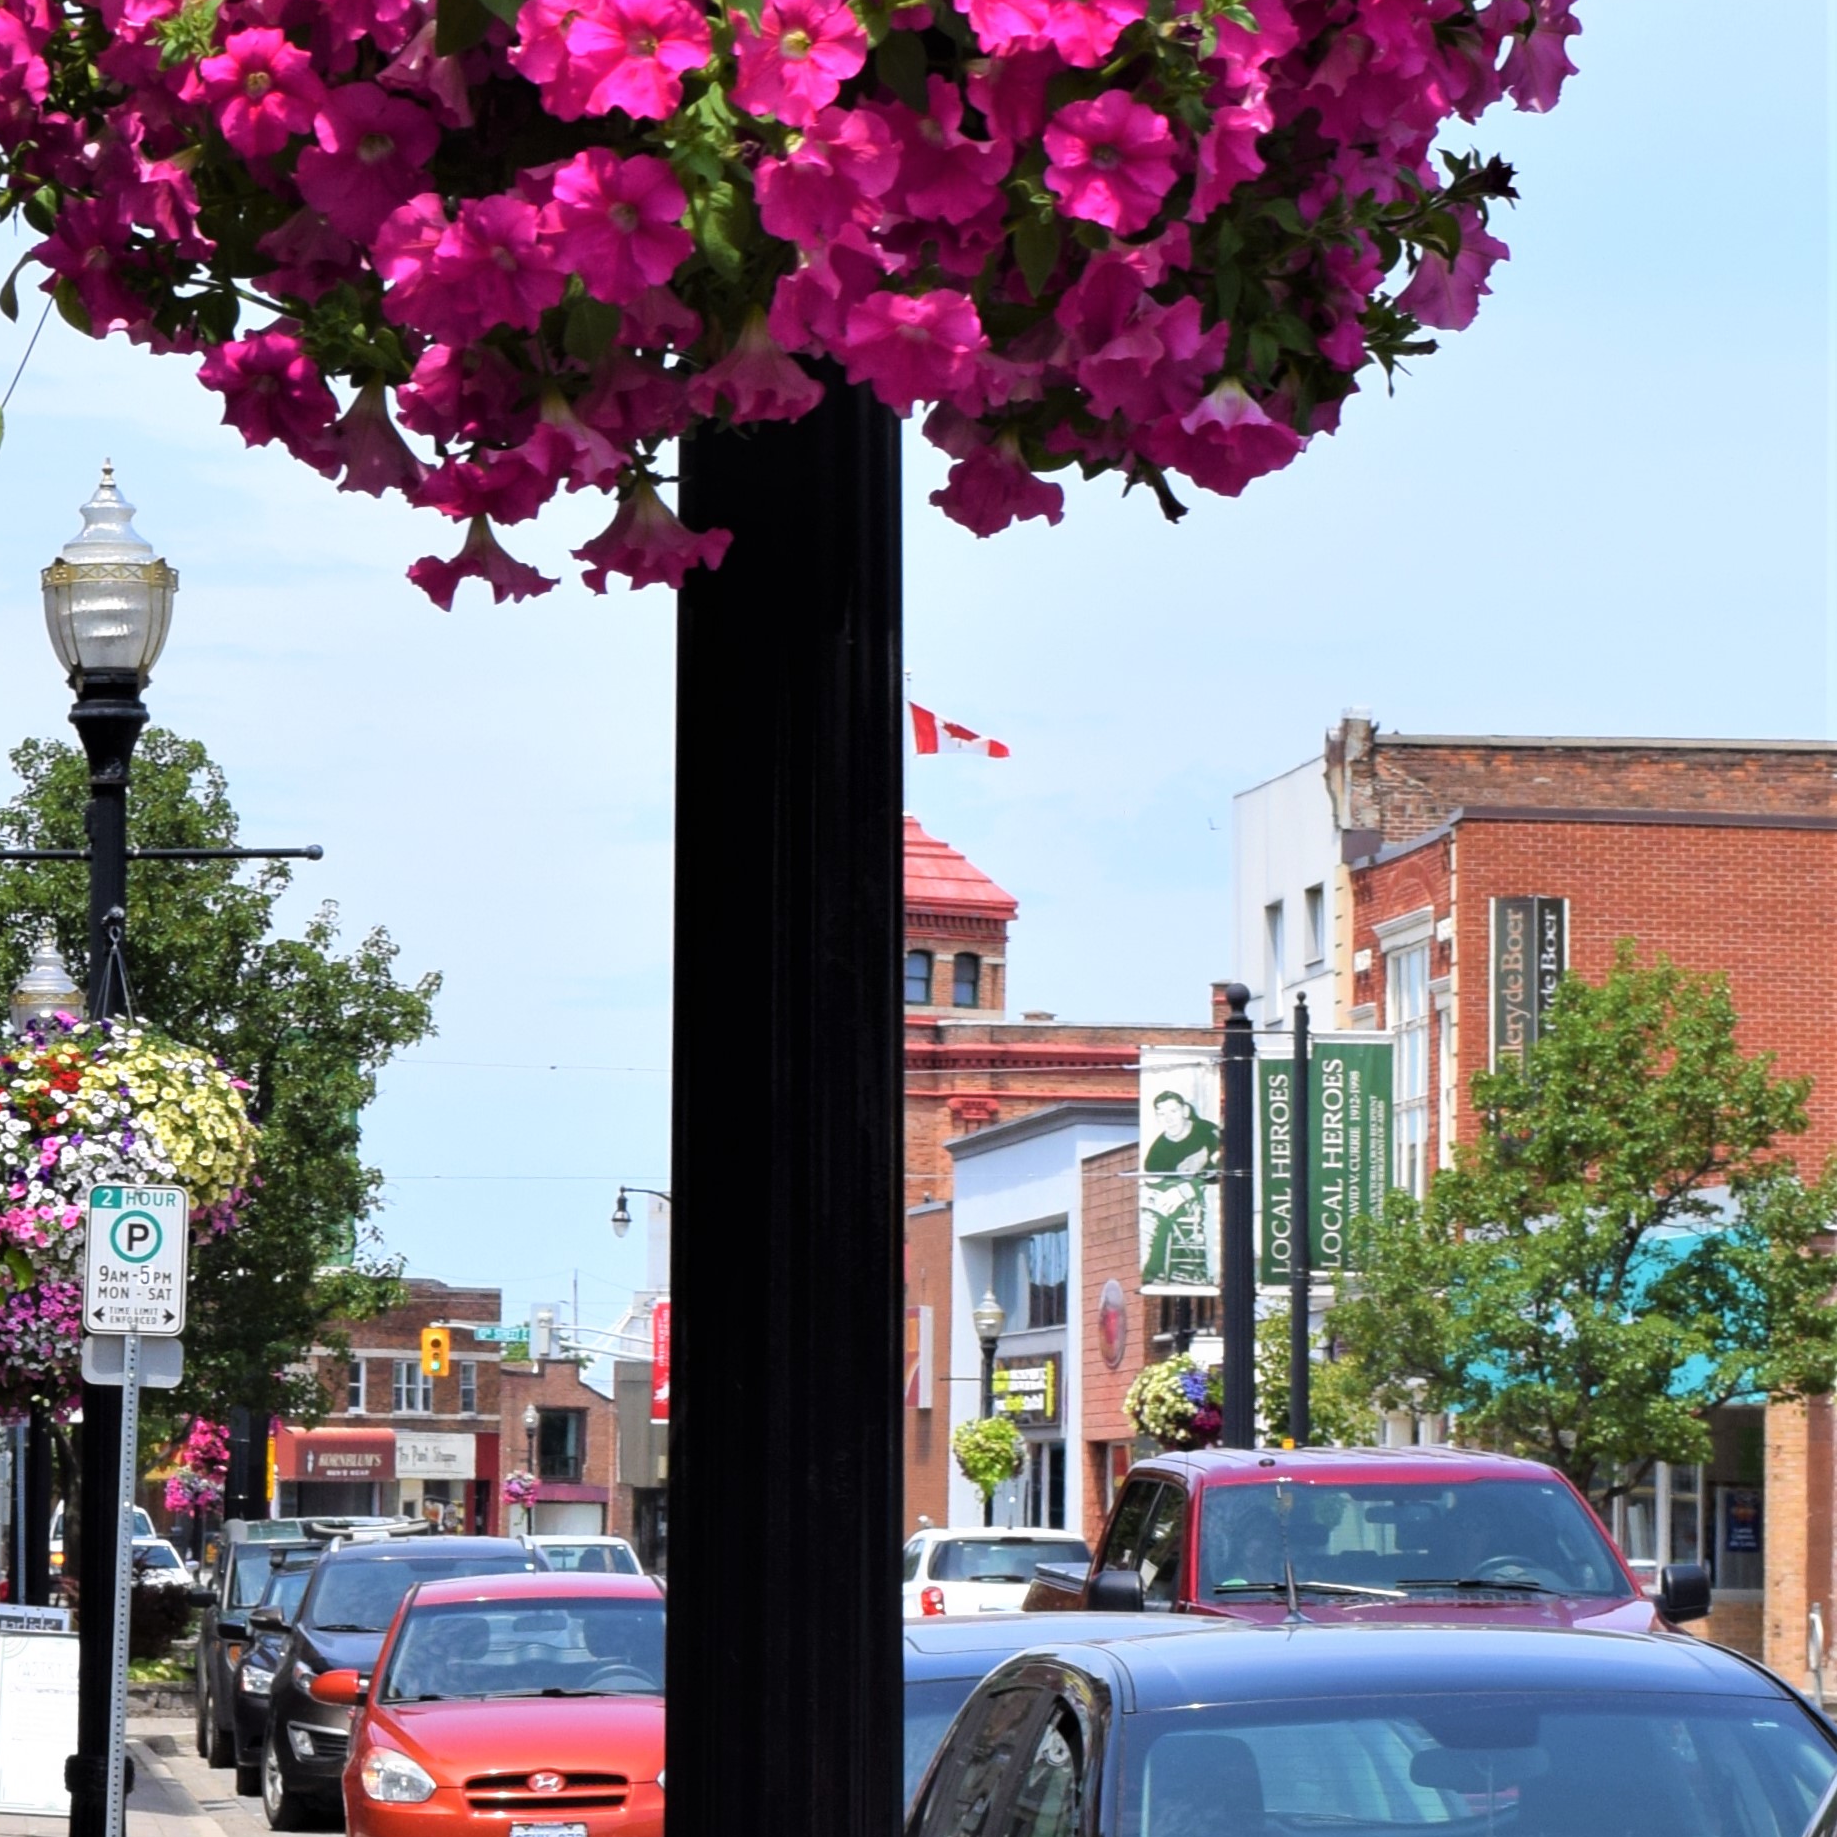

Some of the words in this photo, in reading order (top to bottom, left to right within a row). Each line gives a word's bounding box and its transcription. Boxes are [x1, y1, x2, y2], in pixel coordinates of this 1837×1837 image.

[1501, 908, 1524, 971] Boer
[1541, 909, 1557, 970] Boer
[1501, 975, 1524, 1002] de
[1269, 1073, 1291, 1178] HEROES
[1322, 1059, 1344, 1168] HEROES
[1349, 1127, 1360, 1171] CURRIE
[101, 1190, 113, 1206] 2
[126, 1192, 176, 1207] HOUR
[127, 1223, 149, 1252] P
[1271, 1192, 1292, 1274] LOCAL
[1321, 1179, 1344, 1268] LOCAL
[98, 1287, 130, 1299] MON
[148, 1288, 172, 1300] SAT
[109, 1307, 130, 1315] TIME
[134, 1307, 158, 1315] LIMIT
[110, 1316, 157, 1325] ENFORCED
[319, 1453, 382, 1467] KORNBLUM'S
